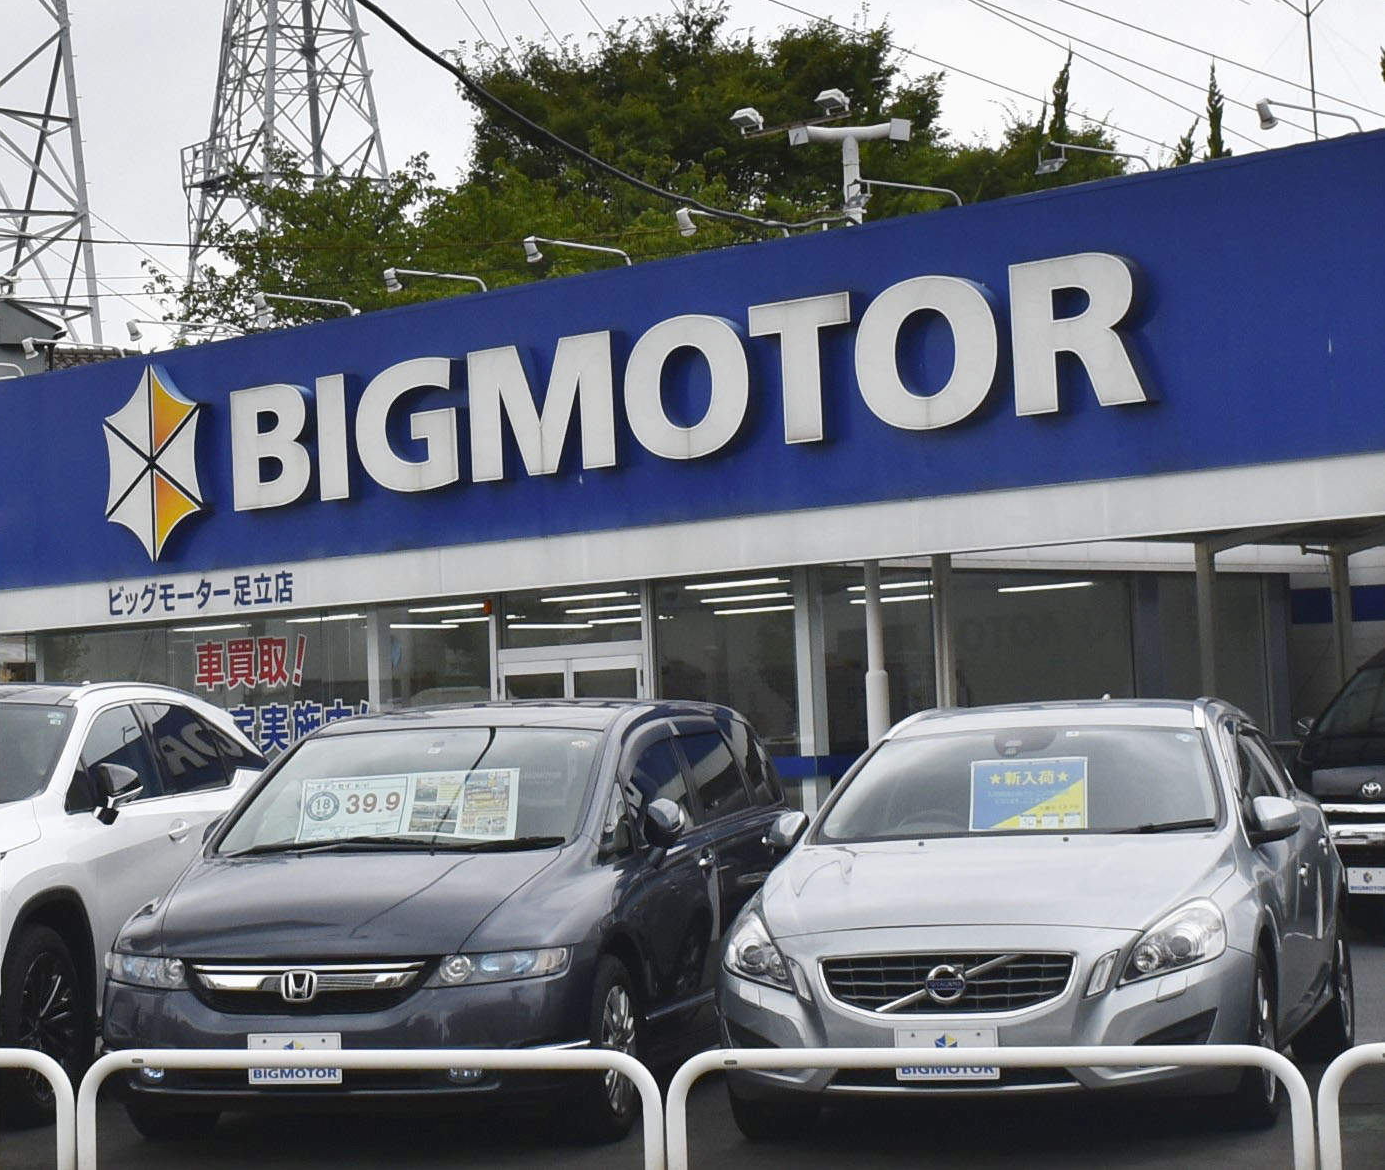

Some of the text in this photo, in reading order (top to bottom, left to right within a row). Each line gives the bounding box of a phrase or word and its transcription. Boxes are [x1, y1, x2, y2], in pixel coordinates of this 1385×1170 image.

[229, 251, 1152, 513] BIGMOTOR
[108, 570, 293, 616] ビッグモーター足立店
[345, 791, 401, 815] 39.9
[253, 1068, 337, 1079] BIGMOTOR
